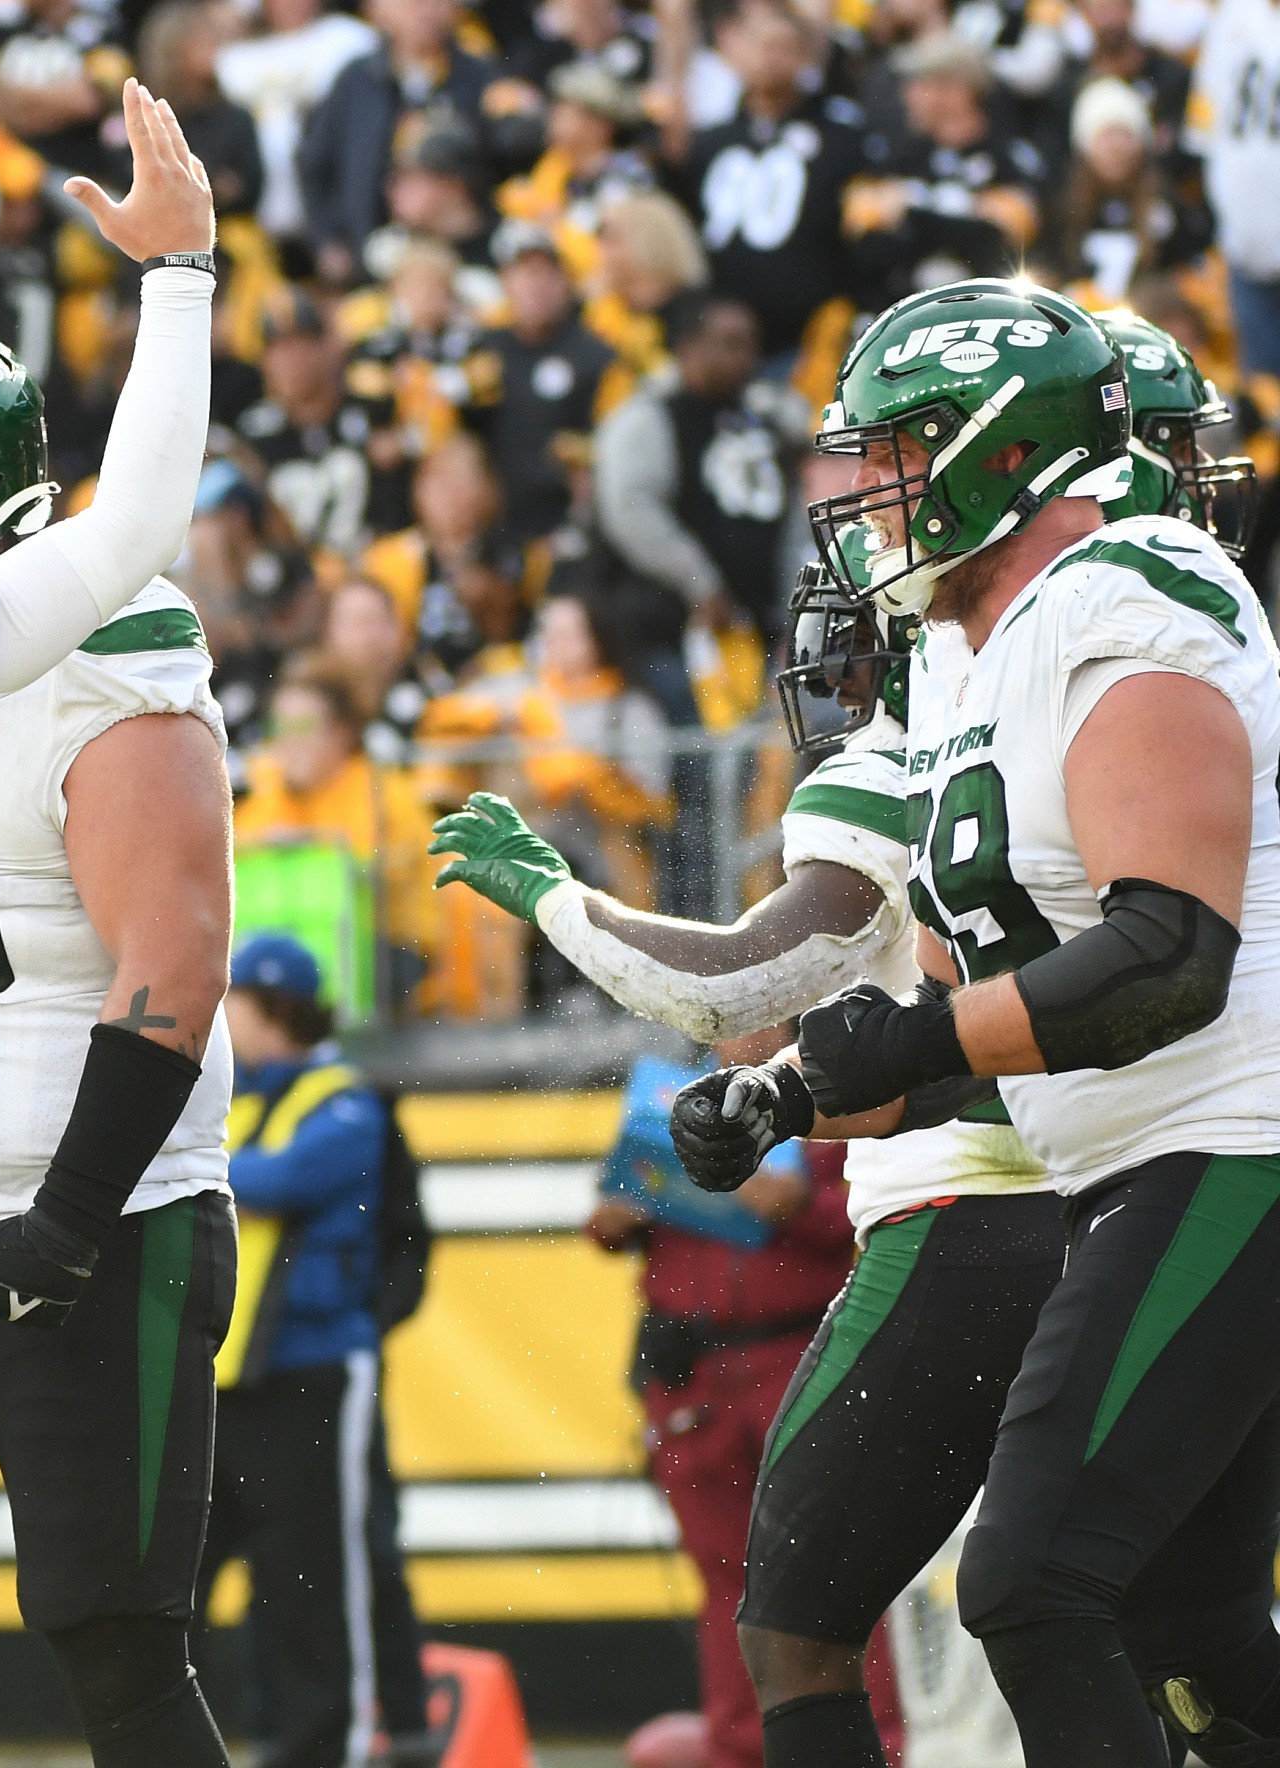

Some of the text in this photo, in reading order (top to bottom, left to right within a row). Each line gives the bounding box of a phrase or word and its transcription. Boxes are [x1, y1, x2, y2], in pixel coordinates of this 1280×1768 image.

[163, 256, 193, 266] TRUST
[883, 318, 1053, 367] JETS
[909, 717, 1000, 777] NEW YORK
